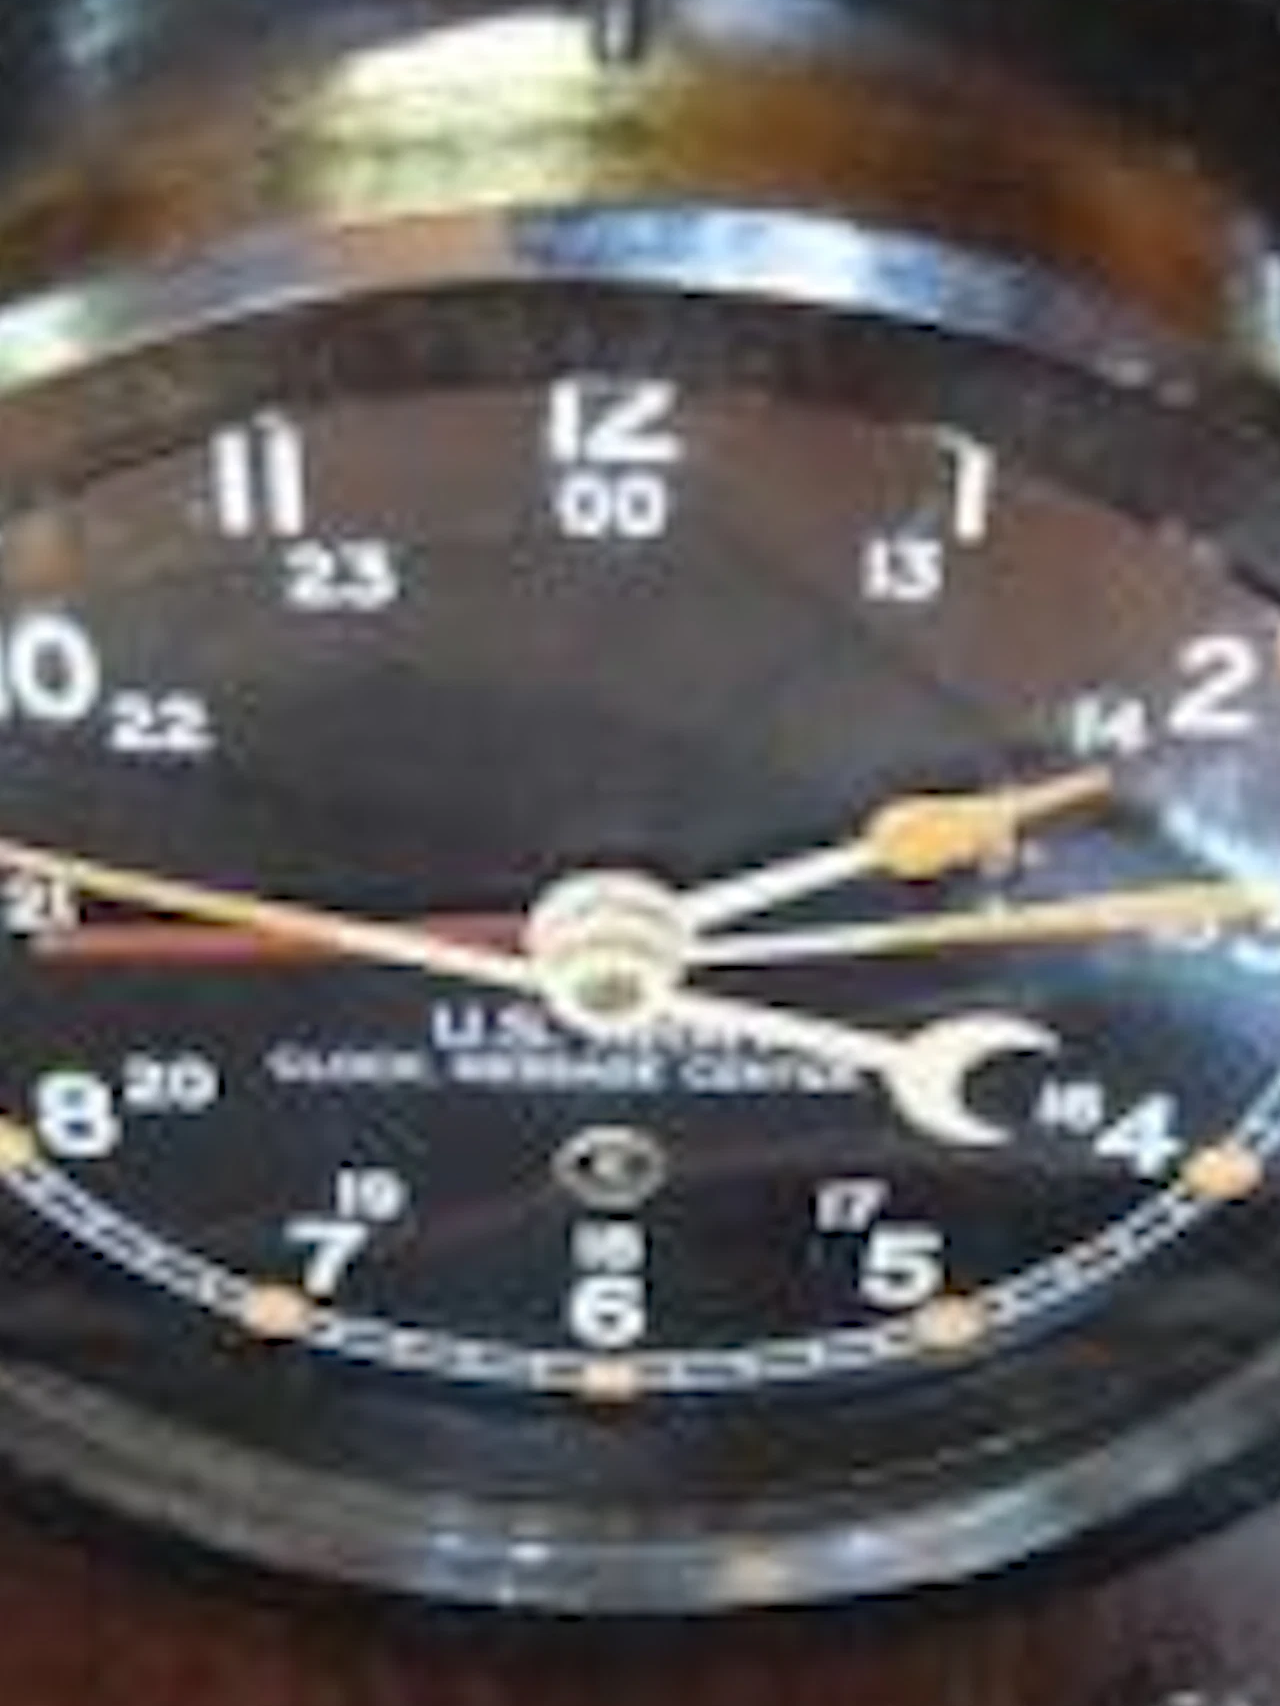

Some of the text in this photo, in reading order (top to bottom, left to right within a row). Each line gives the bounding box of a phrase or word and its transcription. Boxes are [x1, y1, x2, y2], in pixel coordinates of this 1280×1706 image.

[549, 381, 680, 461] 12
[214, 409, 303, 536] 11
[556, 476, 666, 537] 00
[932, 425, 994, 542] 1
[287, 538, 396, 610] 23
[862, 539, 941, 599] 13
[1170, 636, 1260, 734] 2
[106, 695, 216, 750] 22
[1070, 701, 1146, 754] 14
[36, 1071, 120, 1157] 8
[122, 1055, 217, 1111] 20
[1094, 1095, 1180, 1173] 4
[334, 1170, 406, 1220] 19
[816, 1179, 890, 1232] 17
[284, 1222, 369, 1292] 7
[860, 1227, 945, 1309] 5
[569, 1277, 646, 1347] 6
